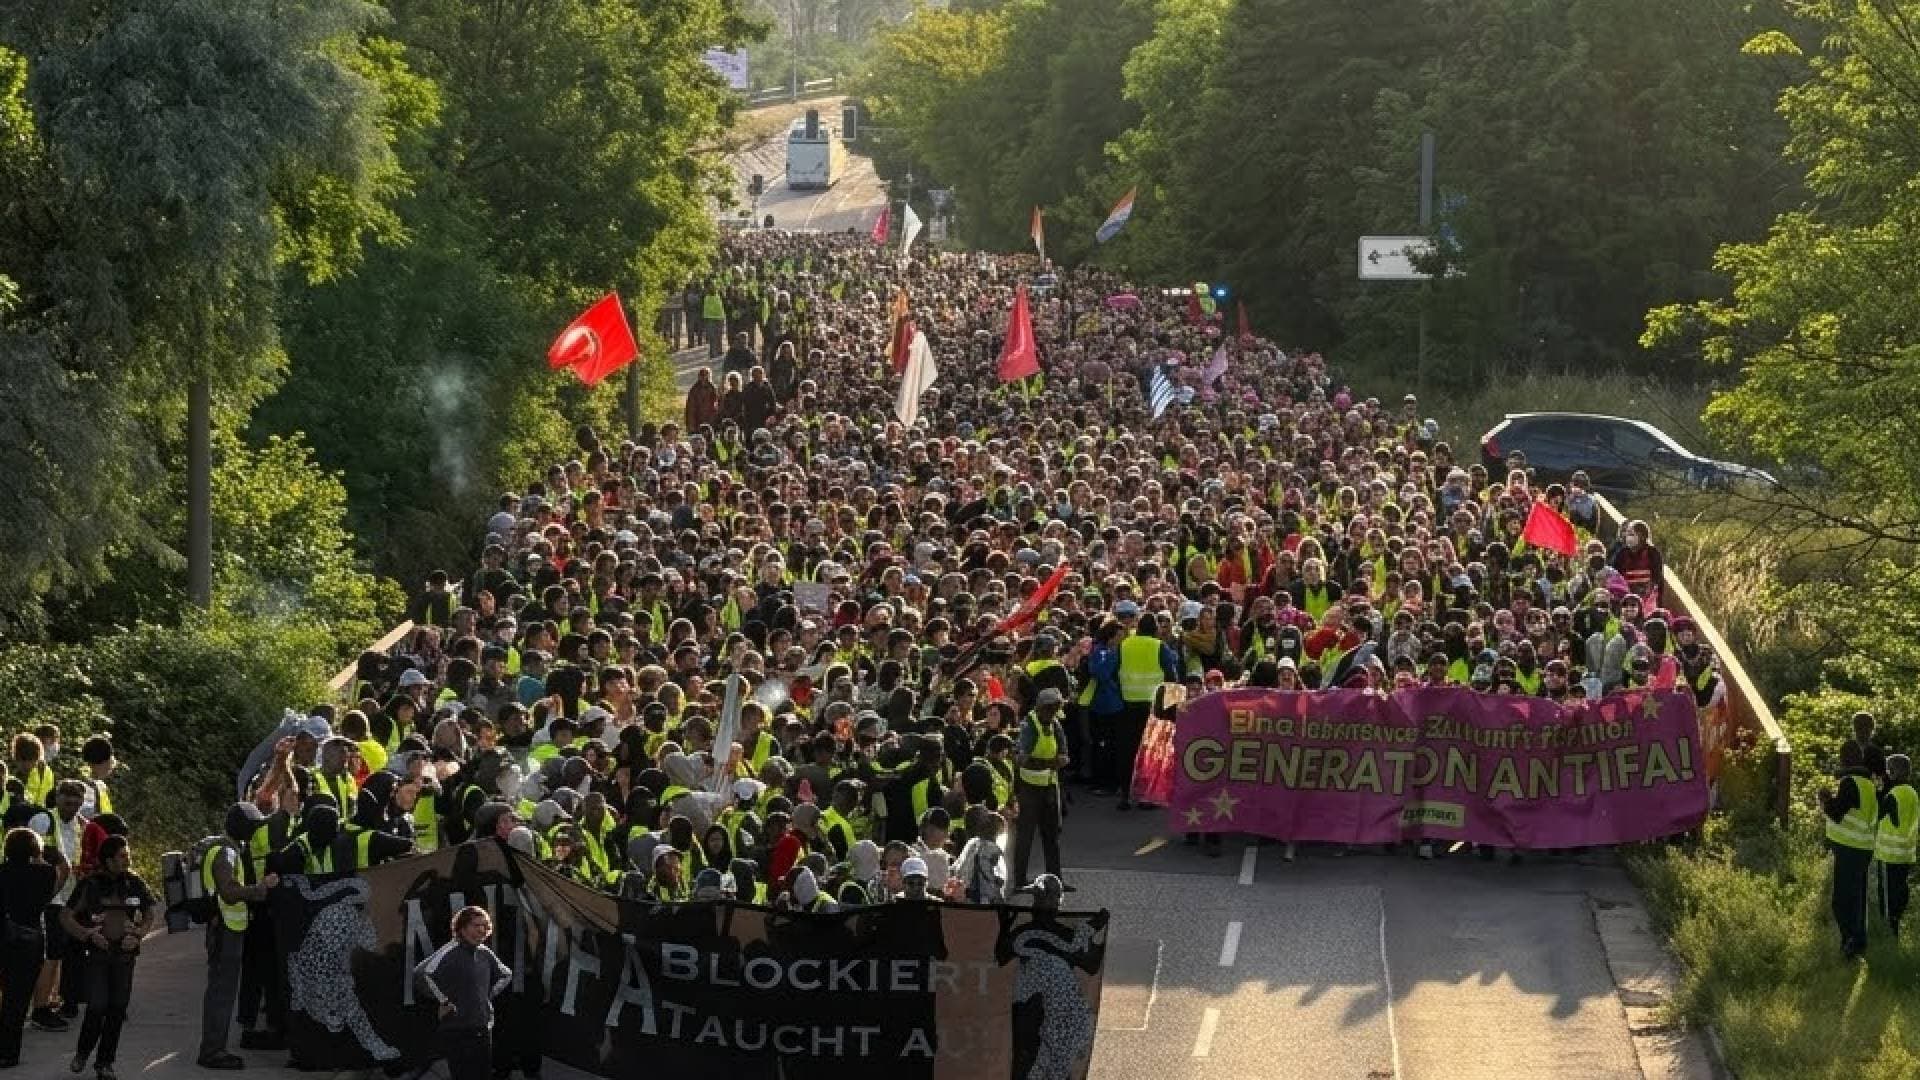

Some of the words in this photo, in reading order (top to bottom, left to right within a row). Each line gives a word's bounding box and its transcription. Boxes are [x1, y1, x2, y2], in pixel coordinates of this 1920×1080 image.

[1488, 736, 1694, 801] ANTIFA!
[660, 942, 996, 995] BLOCKIERT
[660, 1000, 881, 1058] TAUCHT
